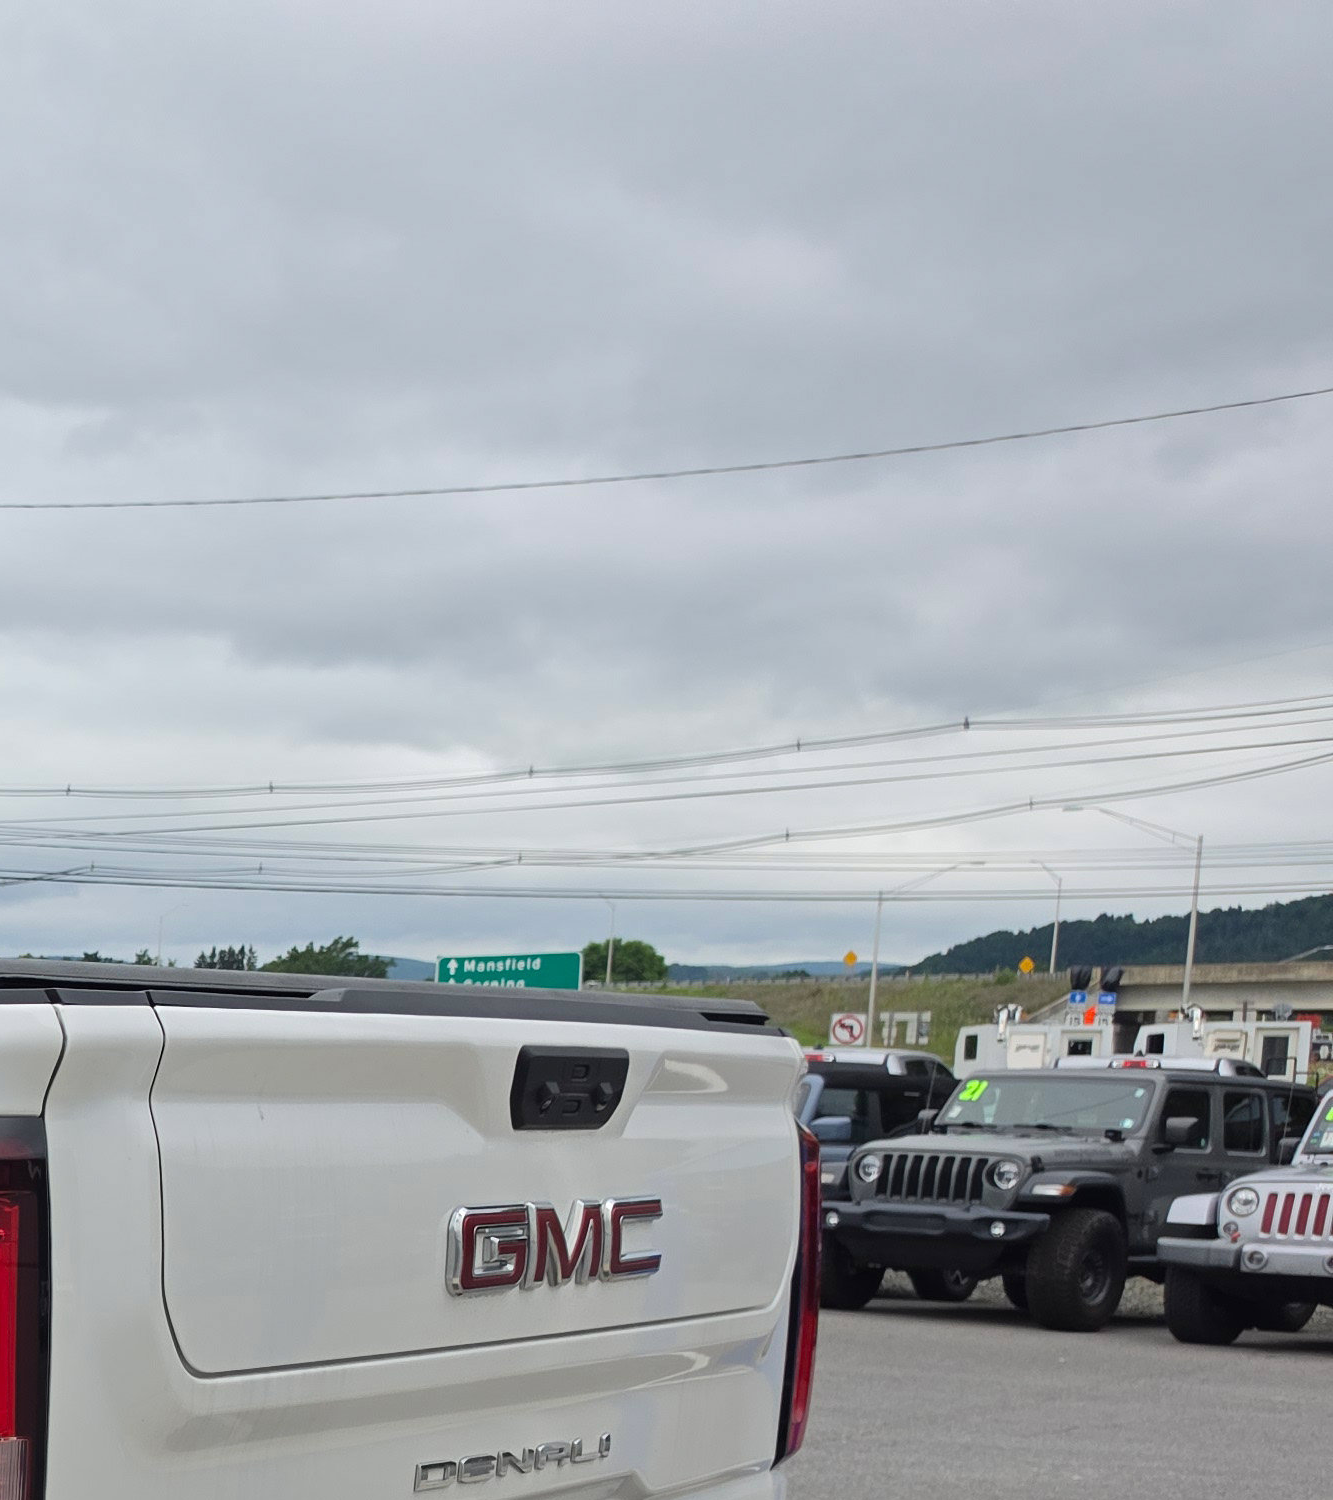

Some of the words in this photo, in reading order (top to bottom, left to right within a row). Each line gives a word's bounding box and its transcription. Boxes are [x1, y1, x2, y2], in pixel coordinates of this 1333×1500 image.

[464, 957, 541, 973] Mansfield
[958, 1079, 989, 1102] 21
[445, 1193, 664, 1298] GMC
[413, 1432, 611, 1493] DENALI
